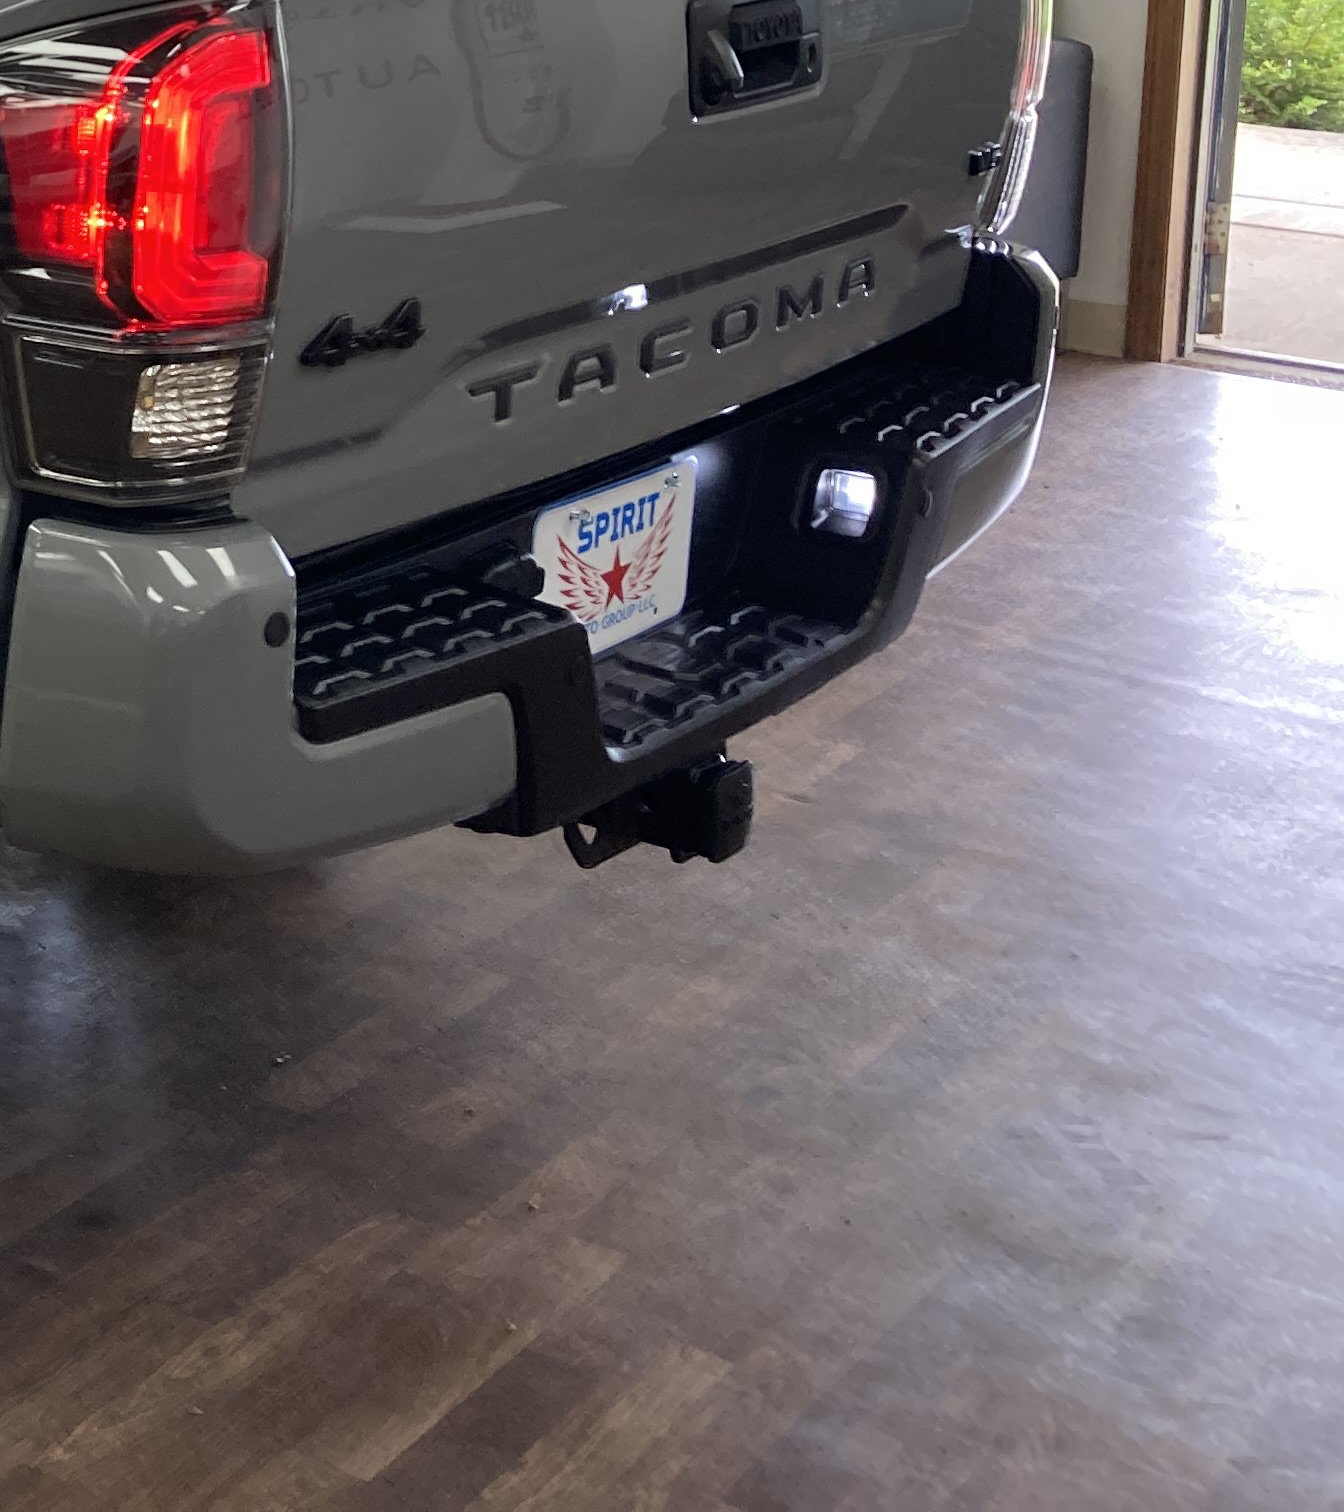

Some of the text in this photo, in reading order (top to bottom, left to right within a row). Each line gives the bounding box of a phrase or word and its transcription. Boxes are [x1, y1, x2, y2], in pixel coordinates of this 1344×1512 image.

[465, 254, 875, 426] TACOMA
[577, 491, 661, 555] SPIRIT
[602, 604, 636, 629] GROUP
